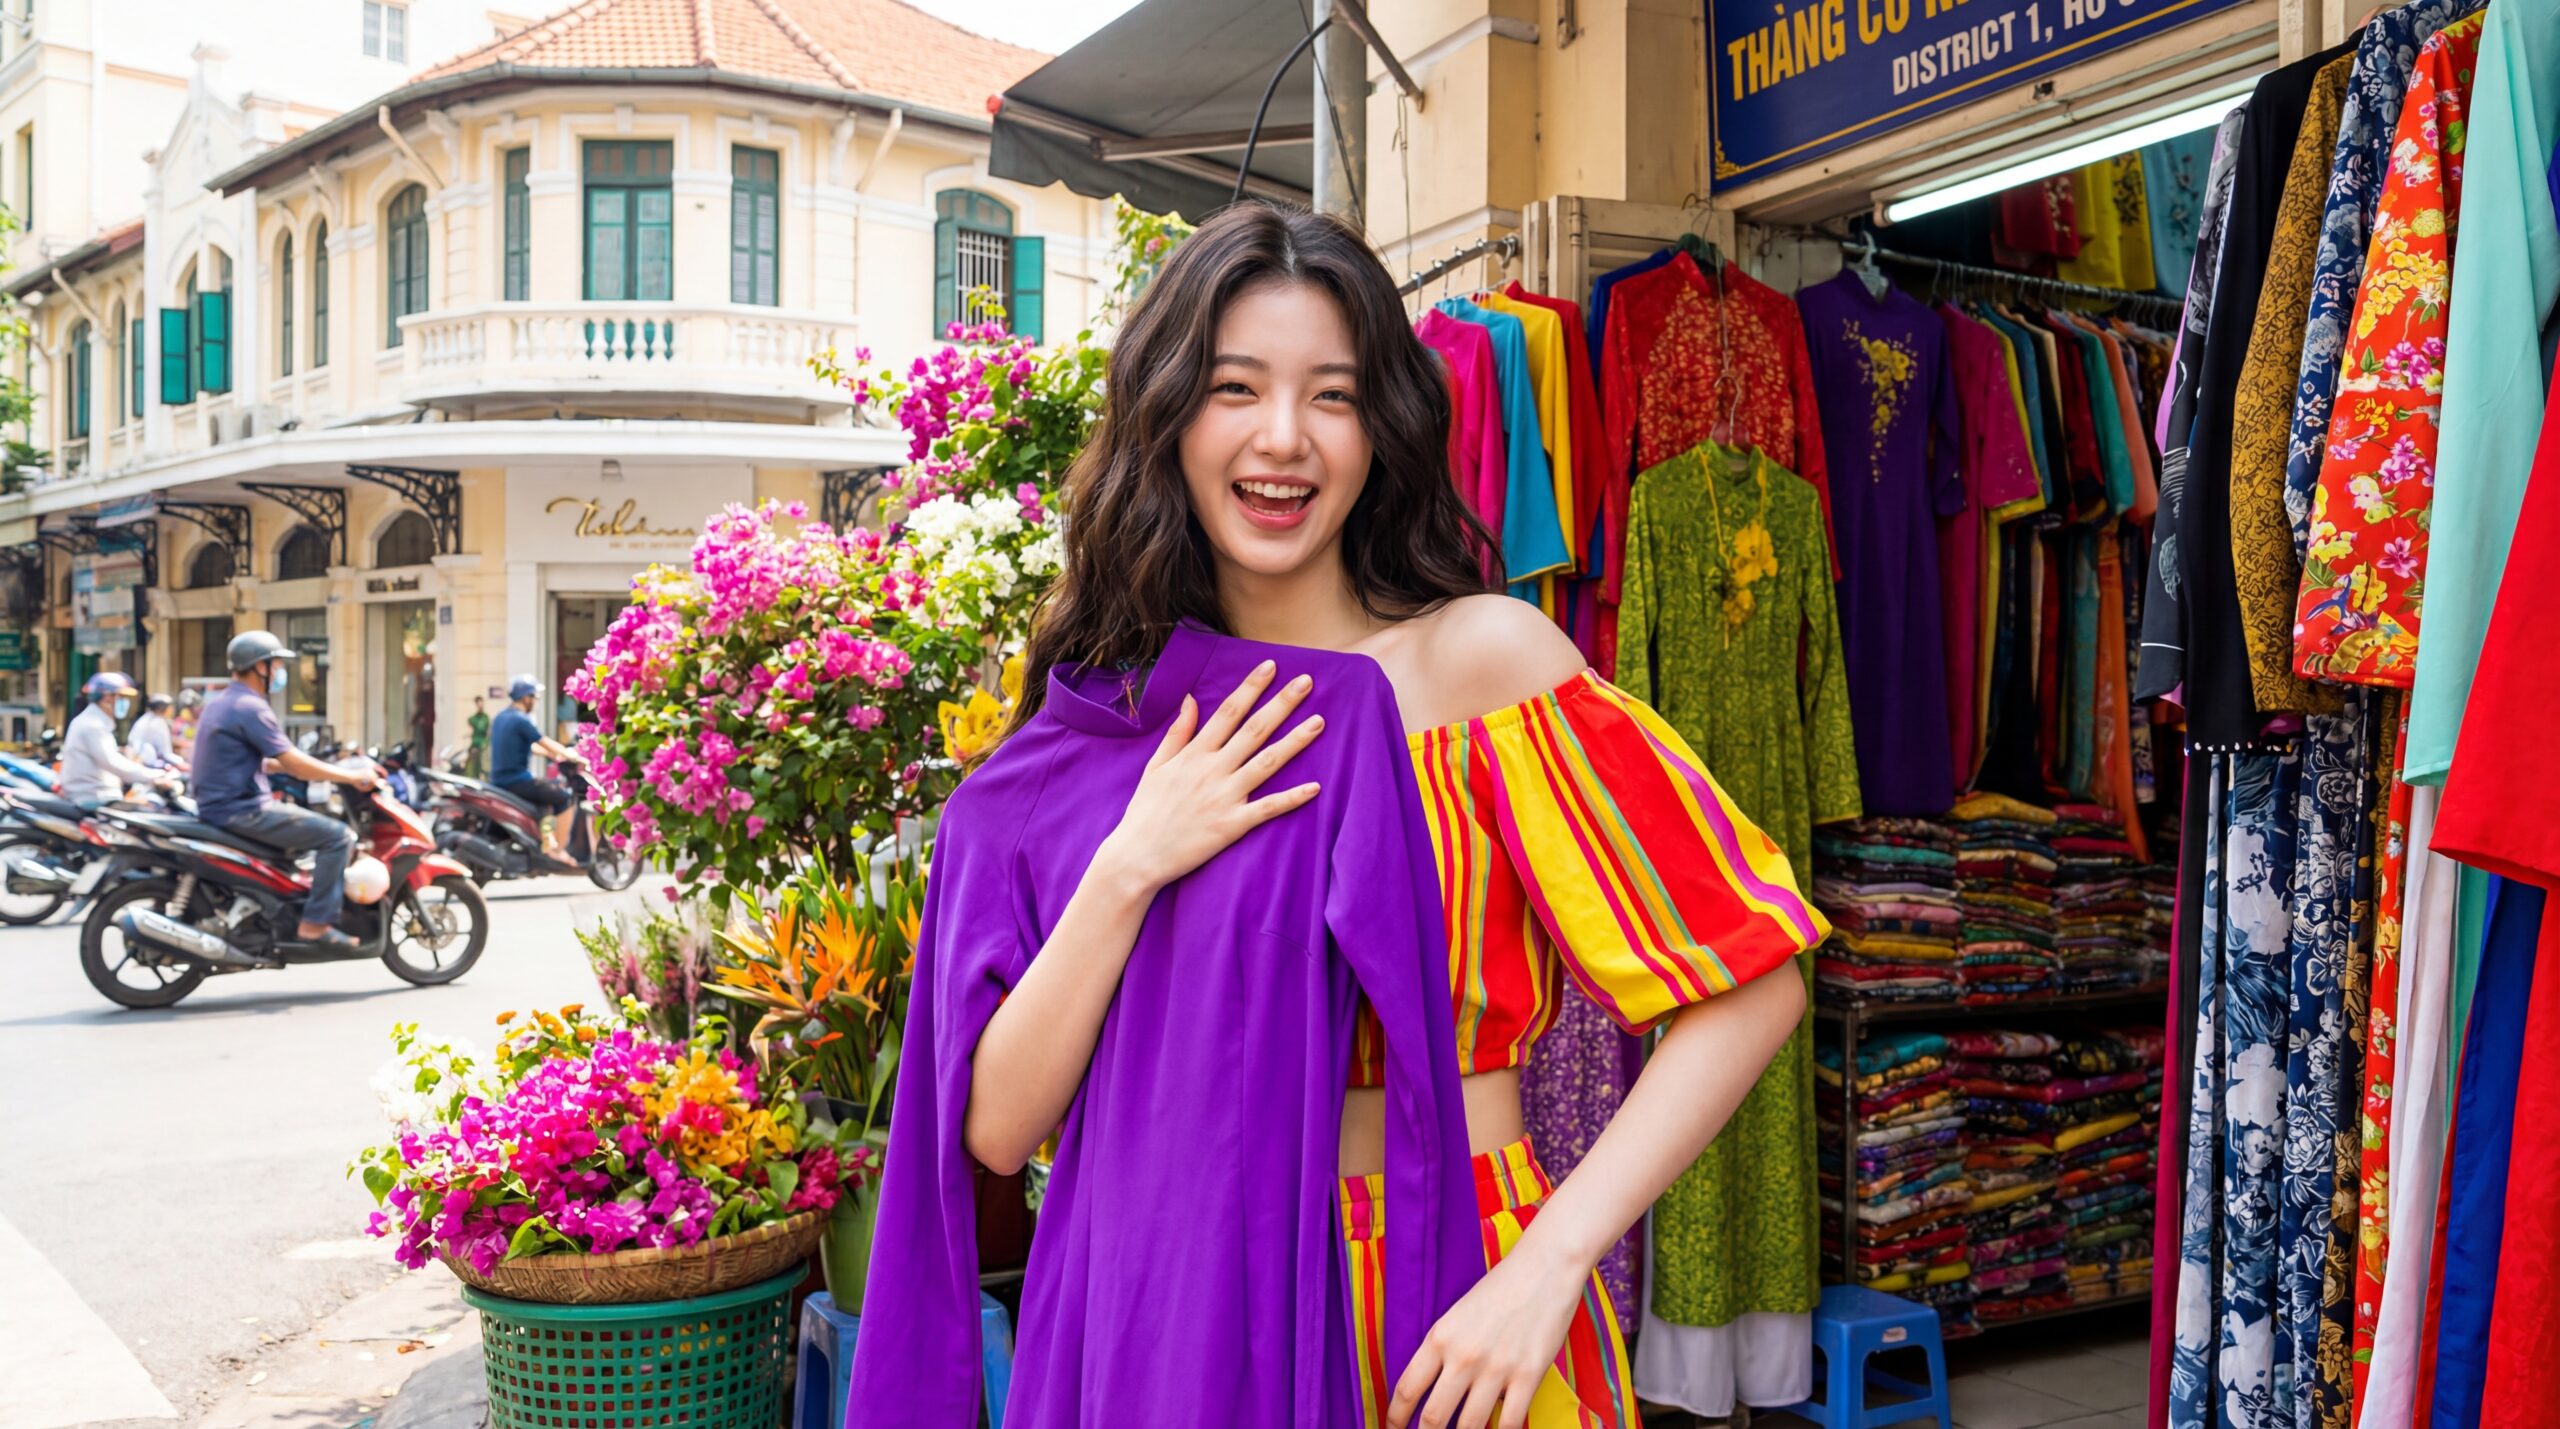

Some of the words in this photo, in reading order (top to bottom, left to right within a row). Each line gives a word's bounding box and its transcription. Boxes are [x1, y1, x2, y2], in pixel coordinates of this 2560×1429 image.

[1727, 0, 1846, 101] THÀNG
[1891, 10, 2016, 96] DISTRICT
[2025, 2, 2053, 43] 1,
